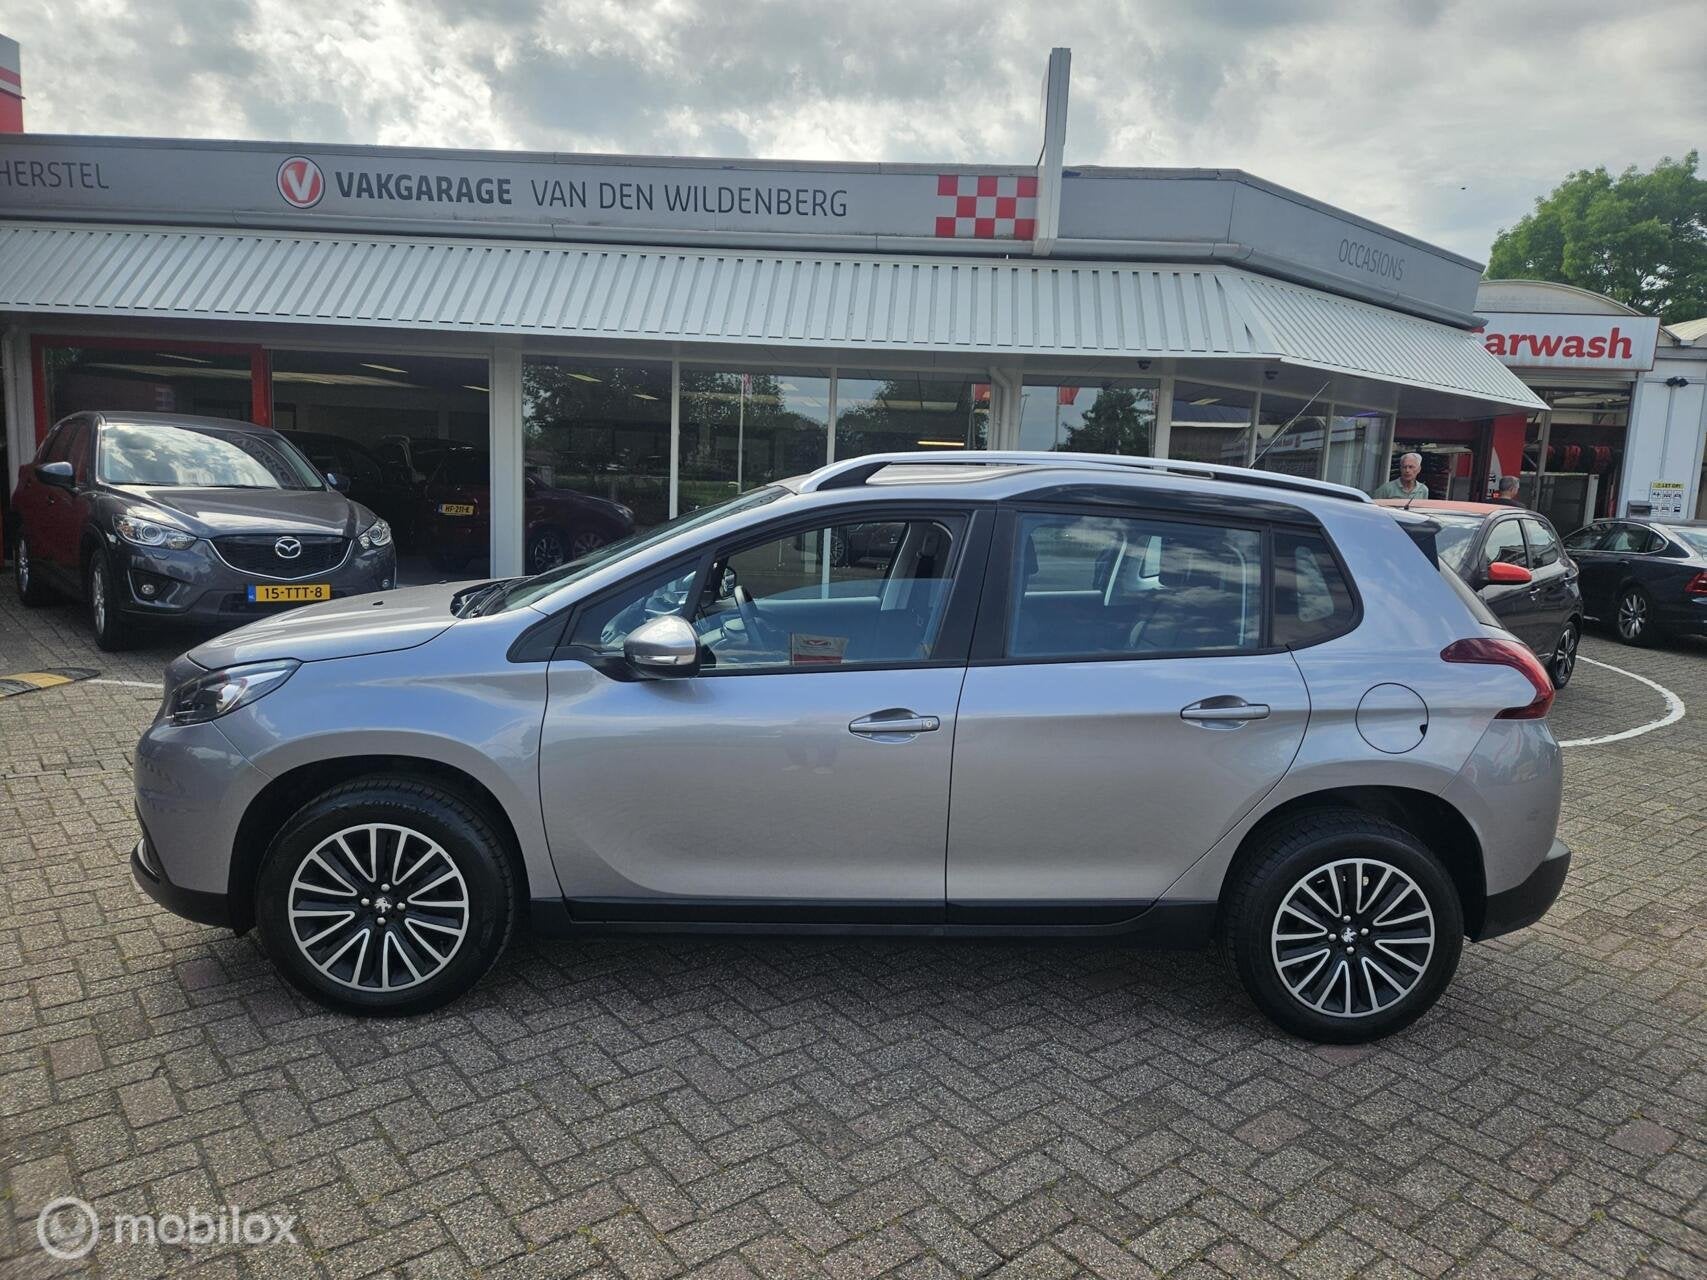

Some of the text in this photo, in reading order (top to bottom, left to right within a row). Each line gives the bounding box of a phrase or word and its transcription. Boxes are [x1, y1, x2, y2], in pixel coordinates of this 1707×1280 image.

[335, 171, 848, 217] VAKGARAGE VAN DEN WILDENBERG
[1338, 238, 1405, 281] OCCASIONS
[1471, 327, 1632, 359] arwash
[264, 586, 323, 599] 15-TTT-8
